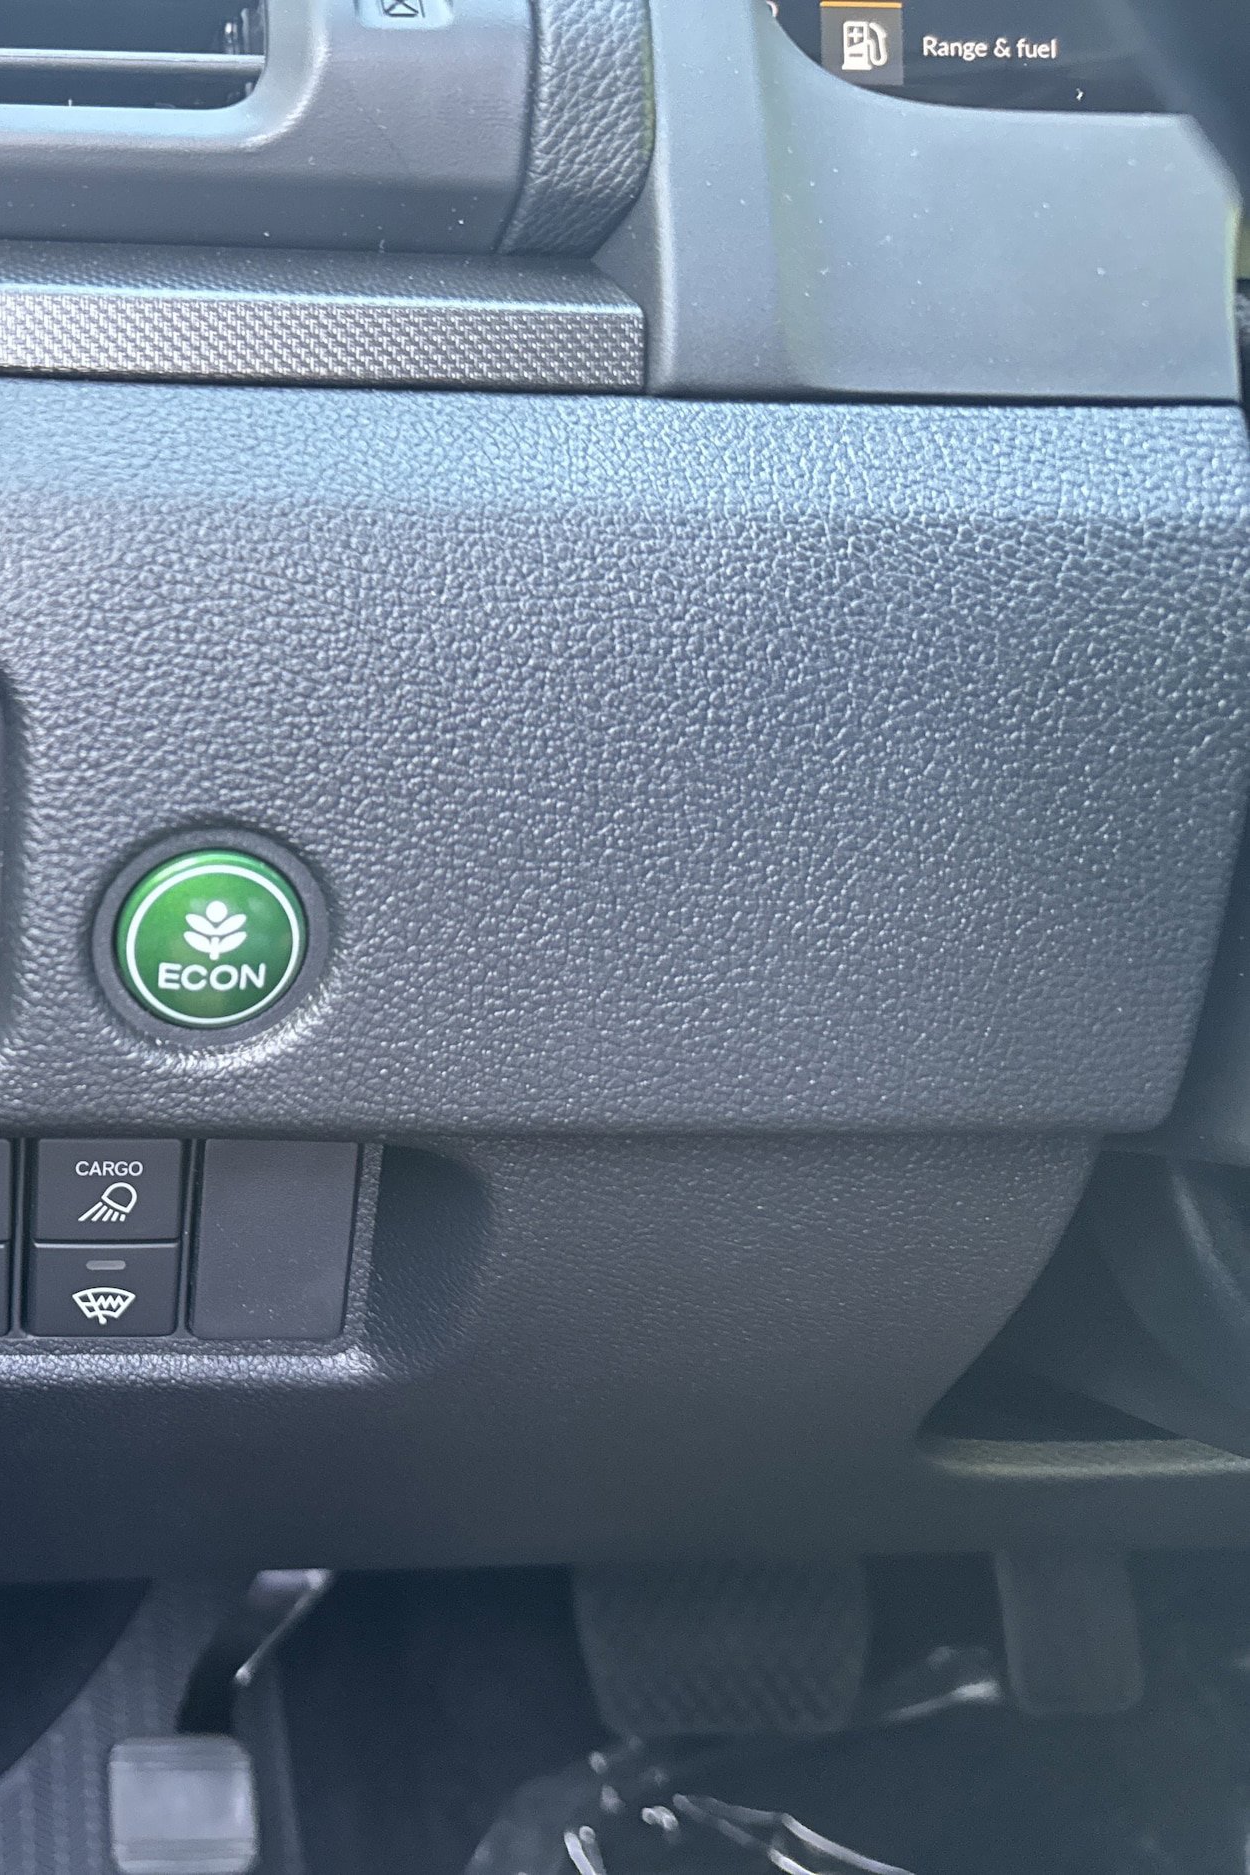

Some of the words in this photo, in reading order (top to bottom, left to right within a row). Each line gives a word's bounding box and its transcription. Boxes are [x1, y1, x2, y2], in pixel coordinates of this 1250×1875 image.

[922, 35, 988, 62] Range
[993, 37, 1012, 59] &
[1016, 37, 1058, 59] fuel
[157, 962, 267, 992] ECON
[75, 1160, 144, 1177] CARGO
